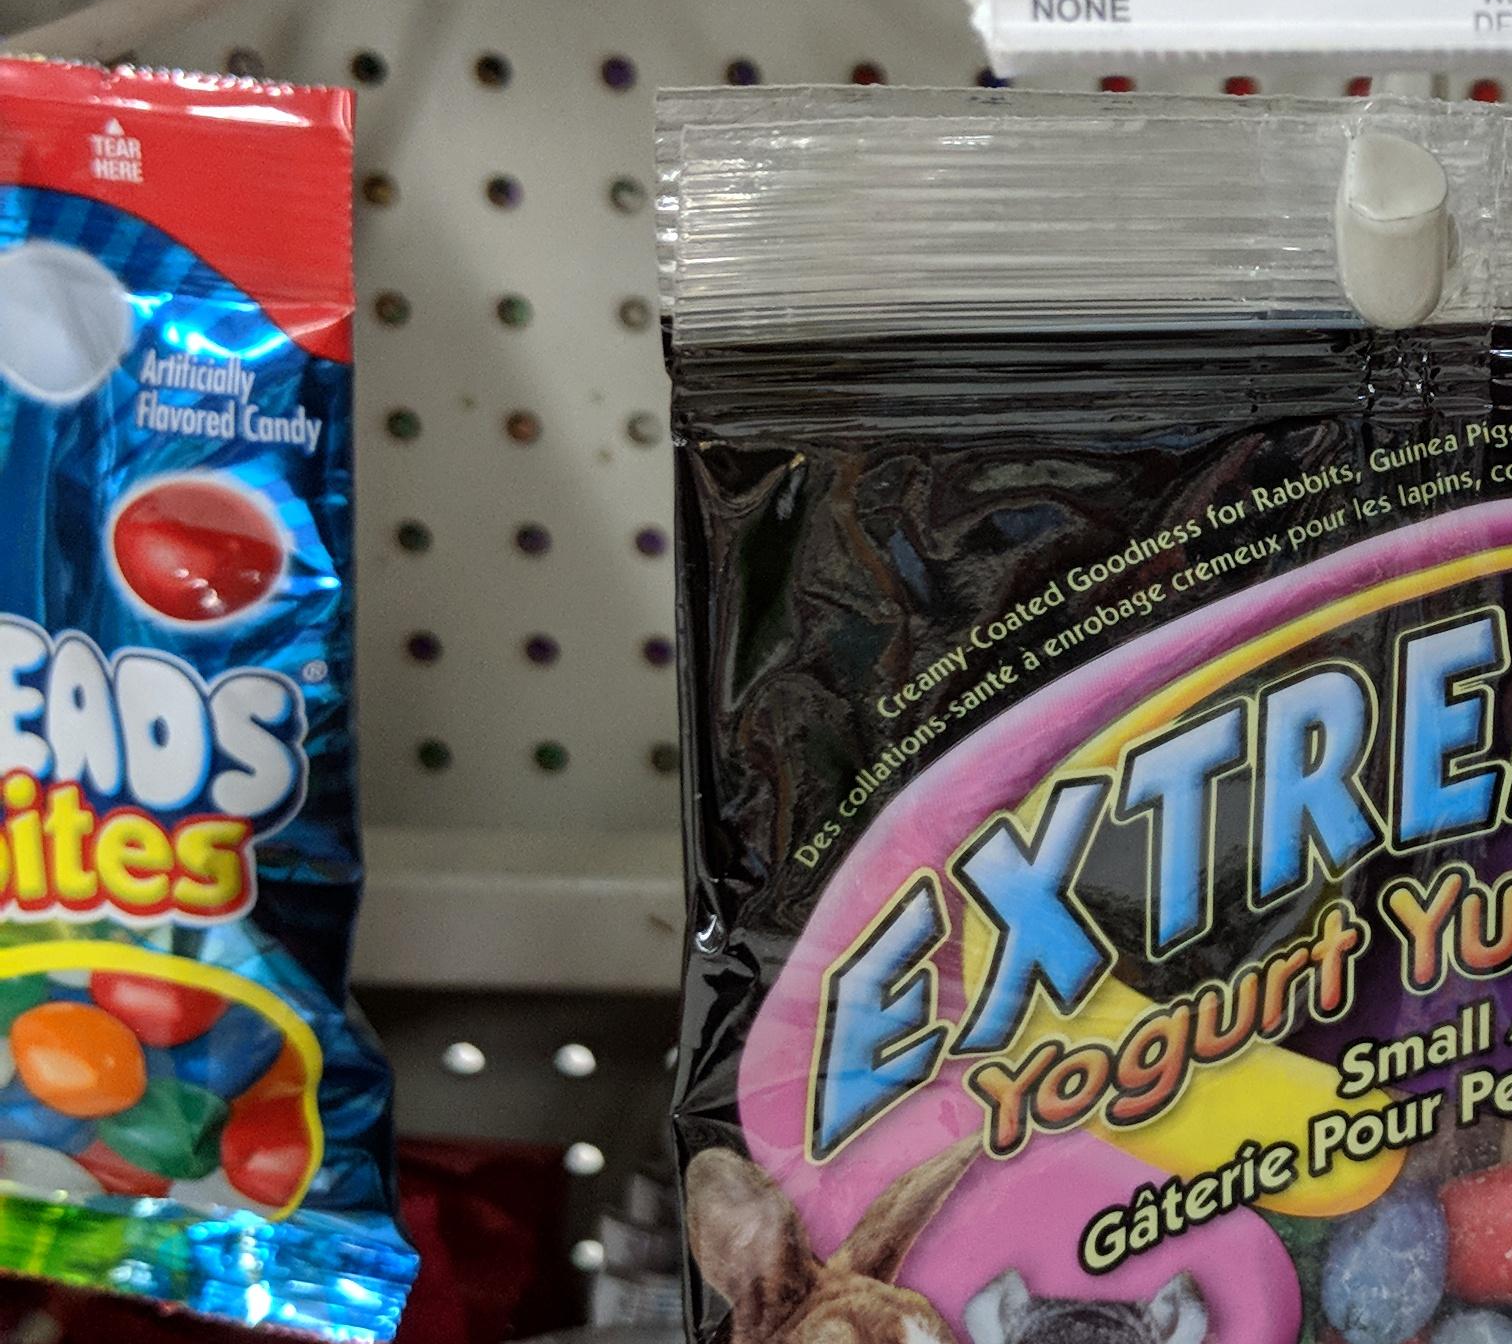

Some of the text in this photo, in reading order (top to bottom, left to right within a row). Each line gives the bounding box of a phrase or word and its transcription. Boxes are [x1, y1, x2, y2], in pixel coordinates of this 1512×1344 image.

[91, 134, 142, 159] TEAR
[93, 159, 144, 183] HERE
[136, 391, 322, 455] Flavored Candy
[140, 349, 257, 400] Artificially
[876, 580, 1067, 720] Creamy-Coated
[1067, 518, 1203, 593] Goodness
[1205, 498, 1248, 531] for
[1250, 464, 1363, 513] Rabbits,
[1369, 433, 1460, 474] Guinea
[793, 819, 843, 869] Des
[1043, 582, 1167, 658] enrobage
[1288, 507, 1346, 552] pour
[1353, 493, 1392, 522] les
[1398, 469, 1482, 508] lapins,
[0, 772, 253, 911] ites
[967, 902, 1368, 1158] Yogurt
[1340, 1001, 1492, 1096] Small
[1082, 1147, 1293, 1274] Gâterie
[1313, 1097, 1440, 1170] Pour
